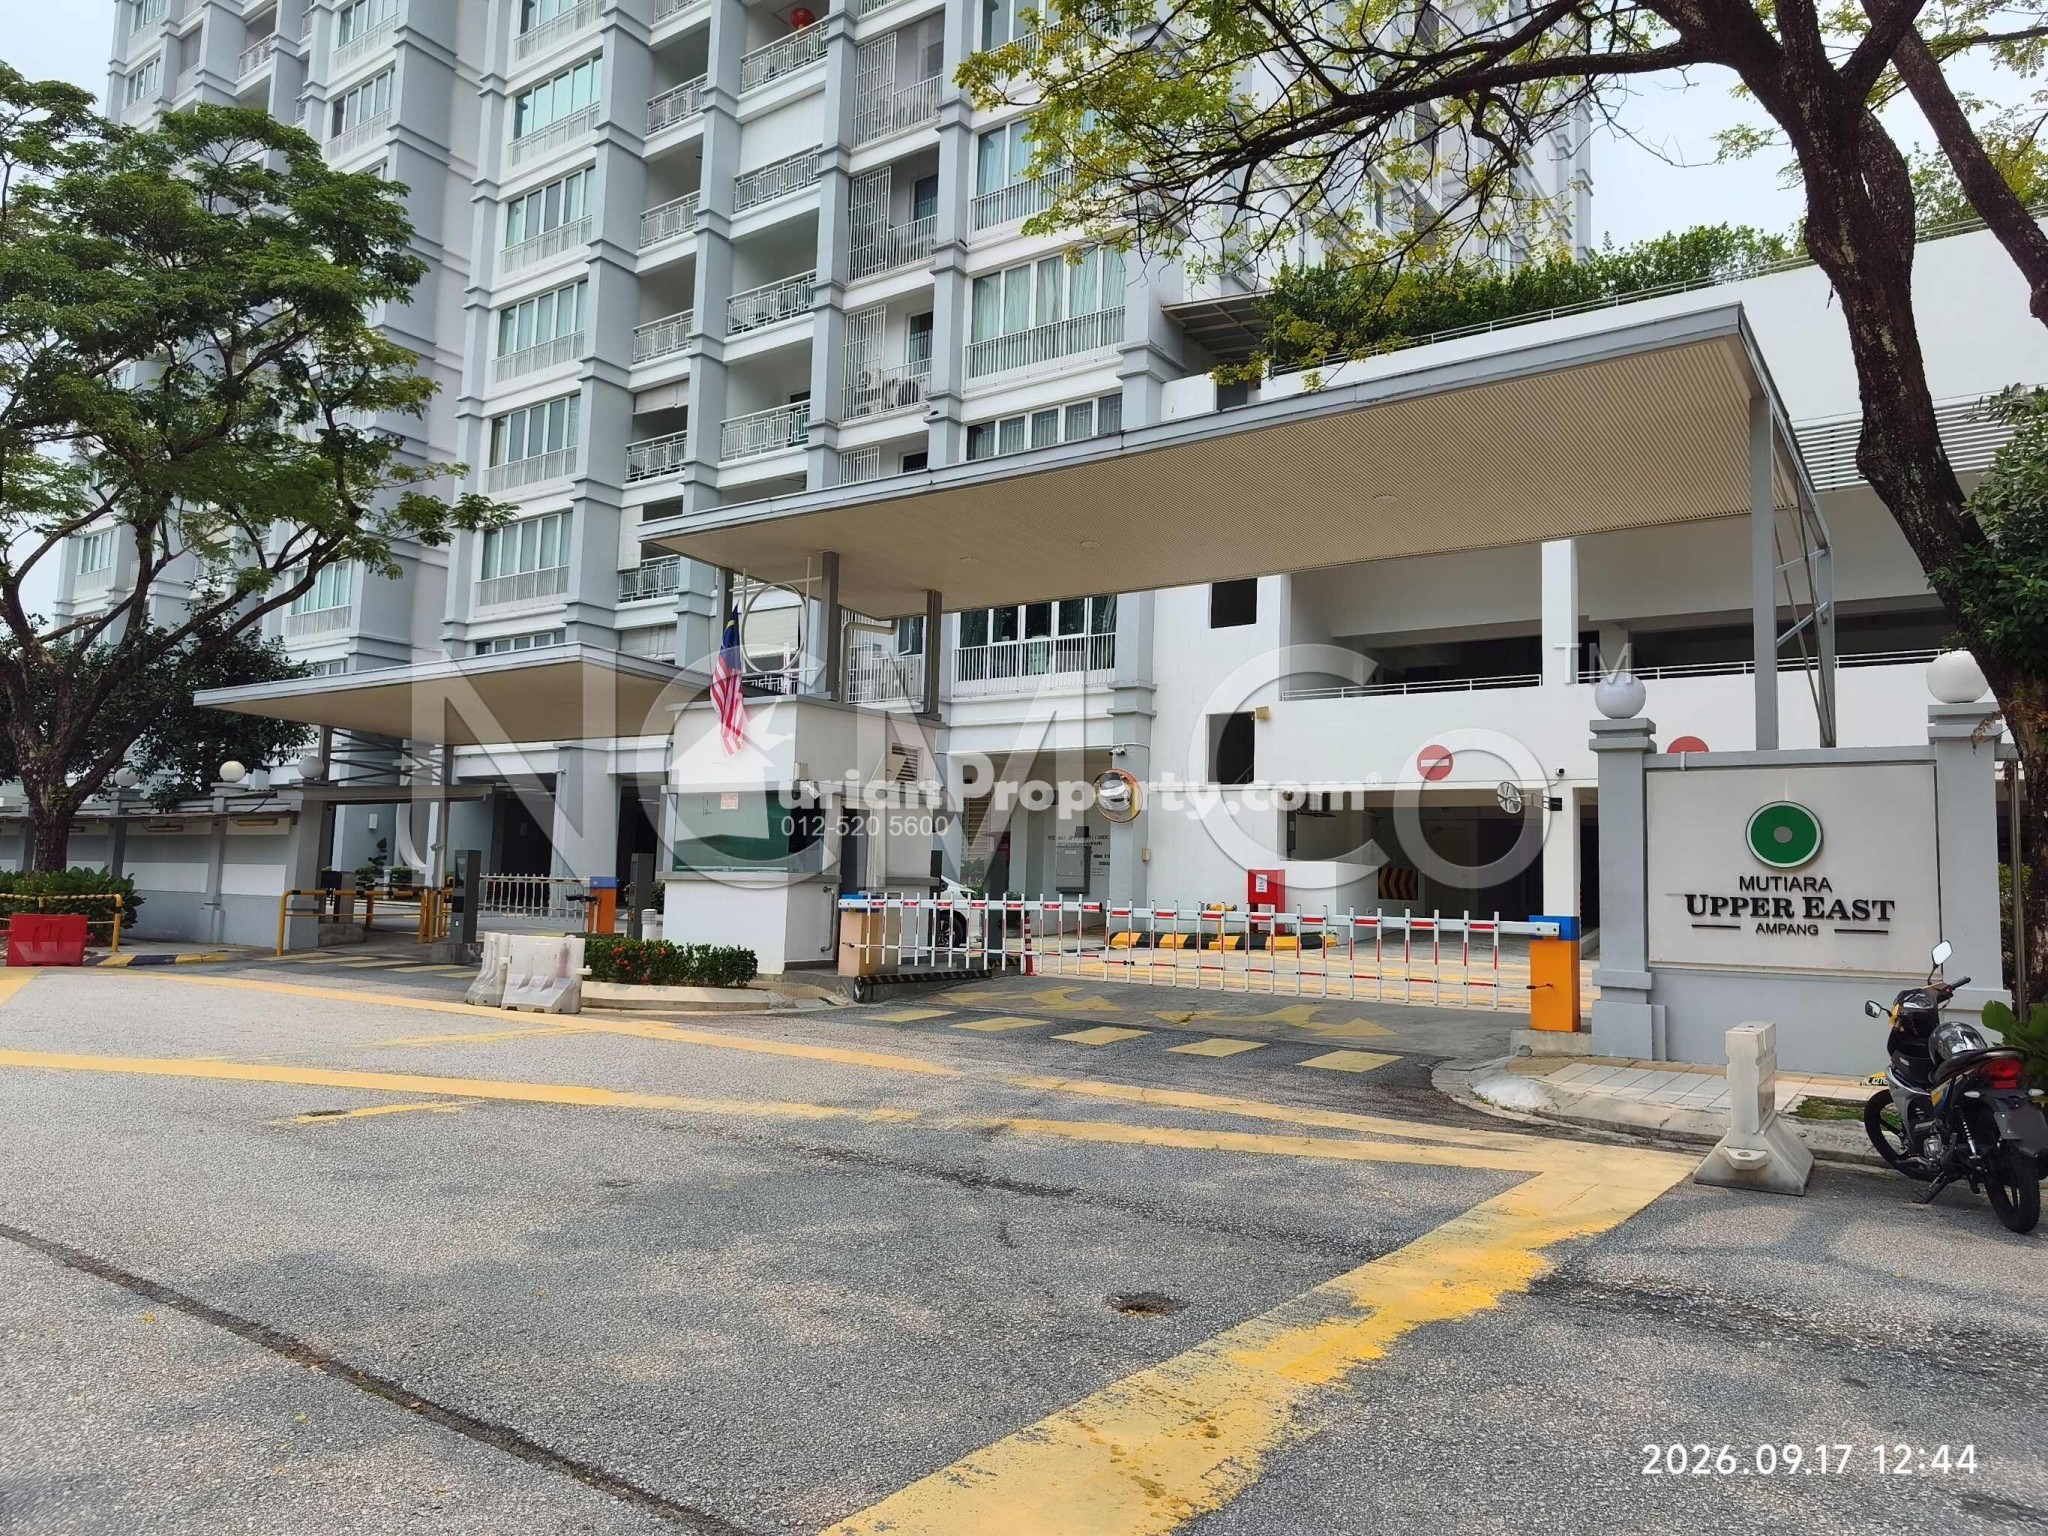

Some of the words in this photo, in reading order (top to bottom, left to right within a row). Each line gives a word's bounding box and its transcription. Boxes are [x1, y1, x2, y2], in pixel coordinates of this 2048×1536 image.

[1739, 876, 1832, 892] MUTIARA
[1685, 894, 1795, 919] UPPER
[1802, 896, 1896, 921] EAST
[1755, 922, 1820, 936] AMPANG
